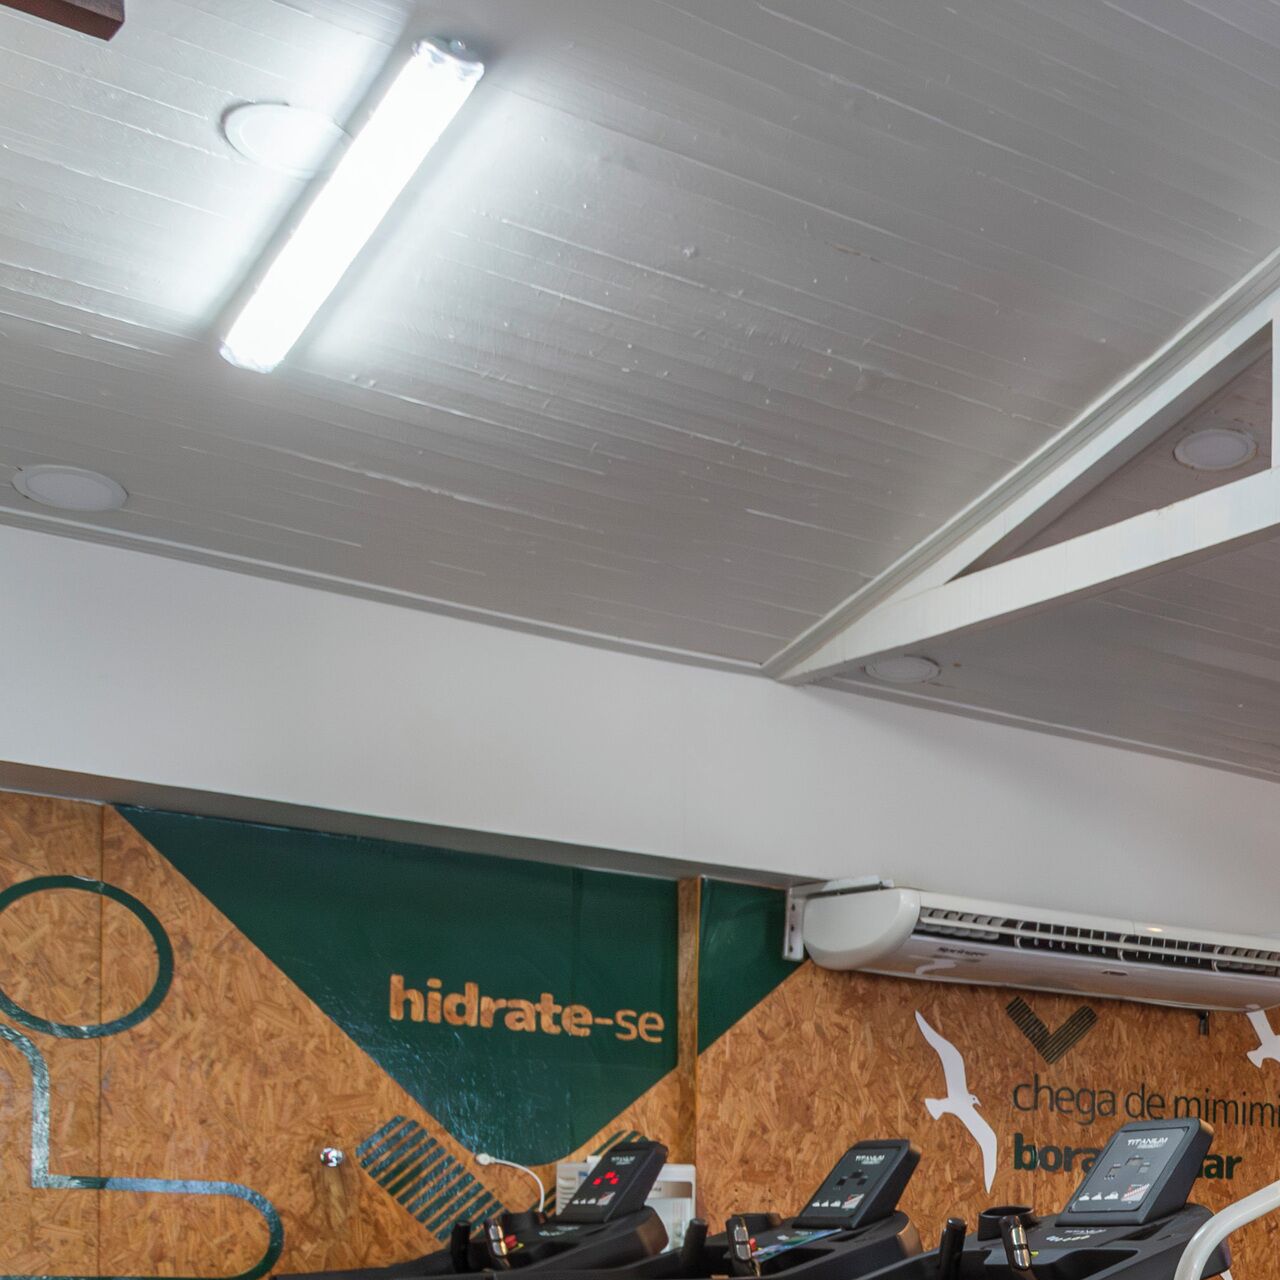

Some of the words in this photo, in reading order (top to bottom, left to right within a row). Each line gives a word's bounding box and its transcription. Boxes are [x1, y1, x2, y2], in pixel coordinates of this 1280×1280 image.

[389, 974, 665, 1043] hidrate-se
[1012, 1073, 1116, 1126] chega
[1125, 1083, 1165, 1119] de
